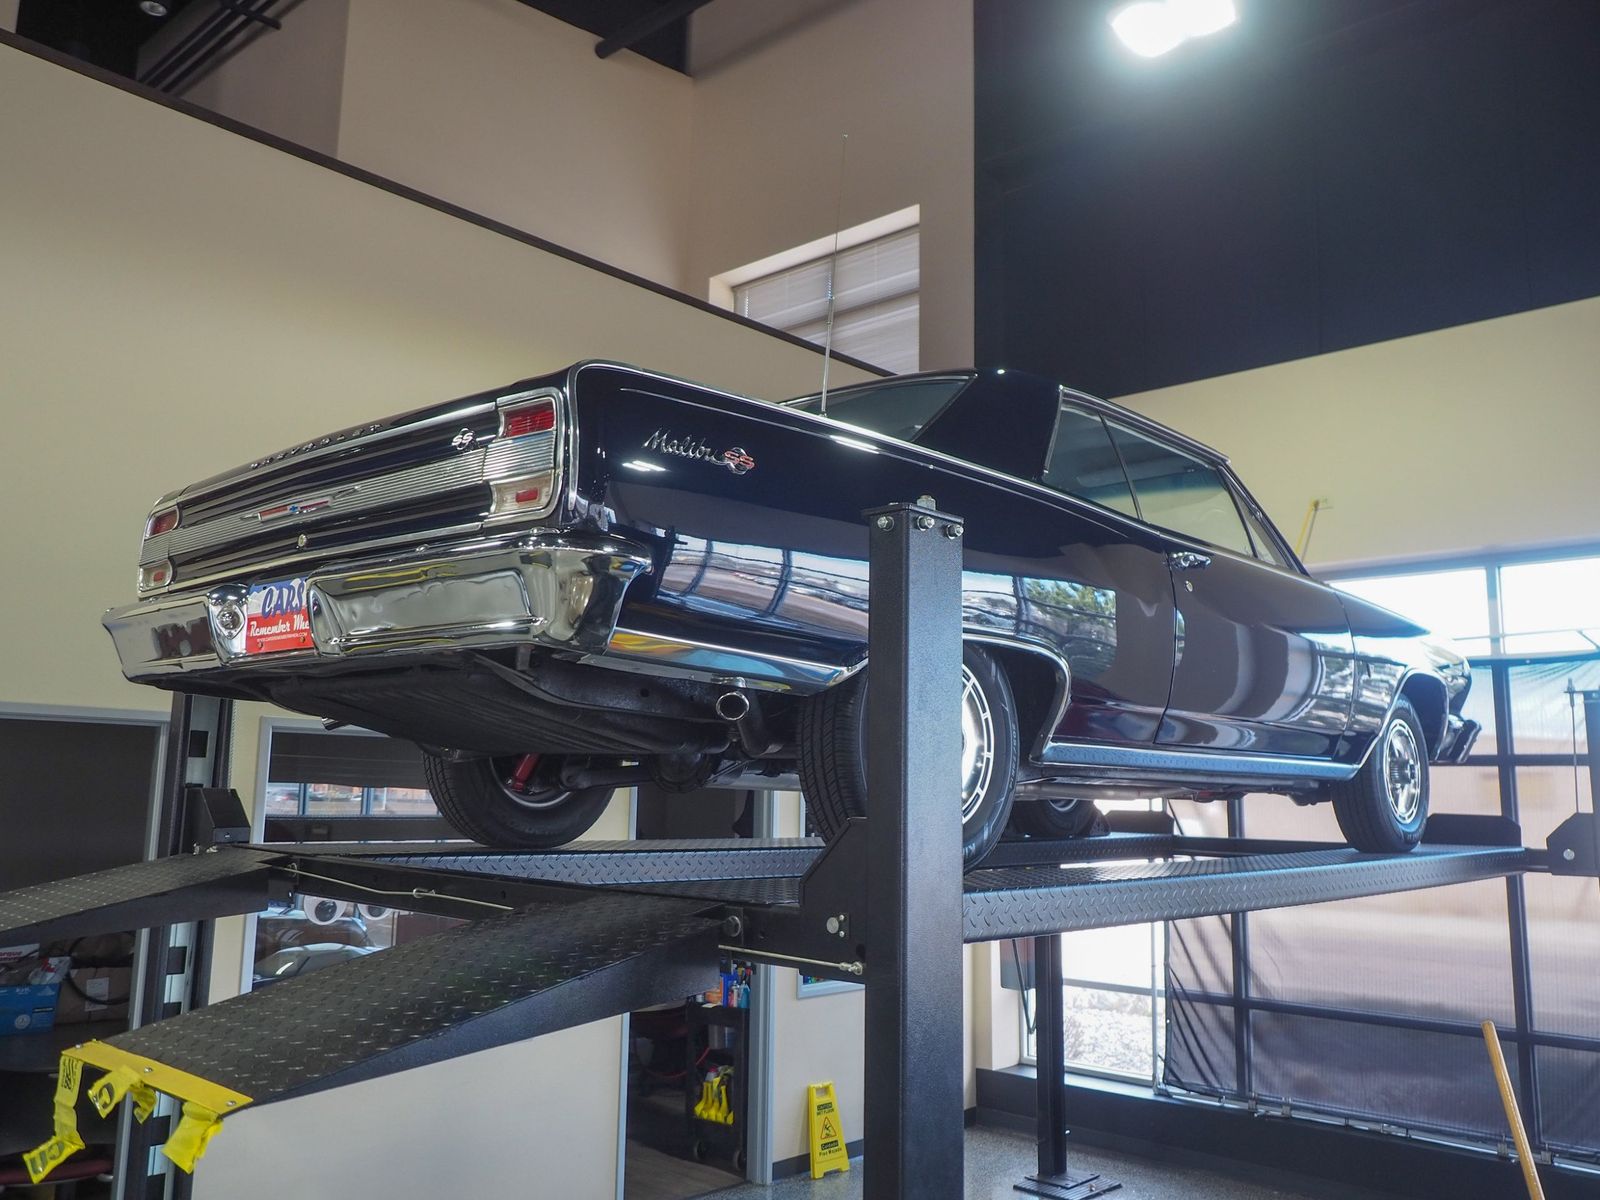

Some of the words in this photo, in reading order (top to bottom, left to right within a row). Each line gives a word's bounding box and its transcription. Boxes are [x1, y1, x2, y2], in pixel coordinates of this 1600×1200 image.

[641, 427, 721, 464] Malibu
[724, 450, 755, 469] SS
[261, 580, 306, 619] CARS
[249, 620, 291, 637] Remember
